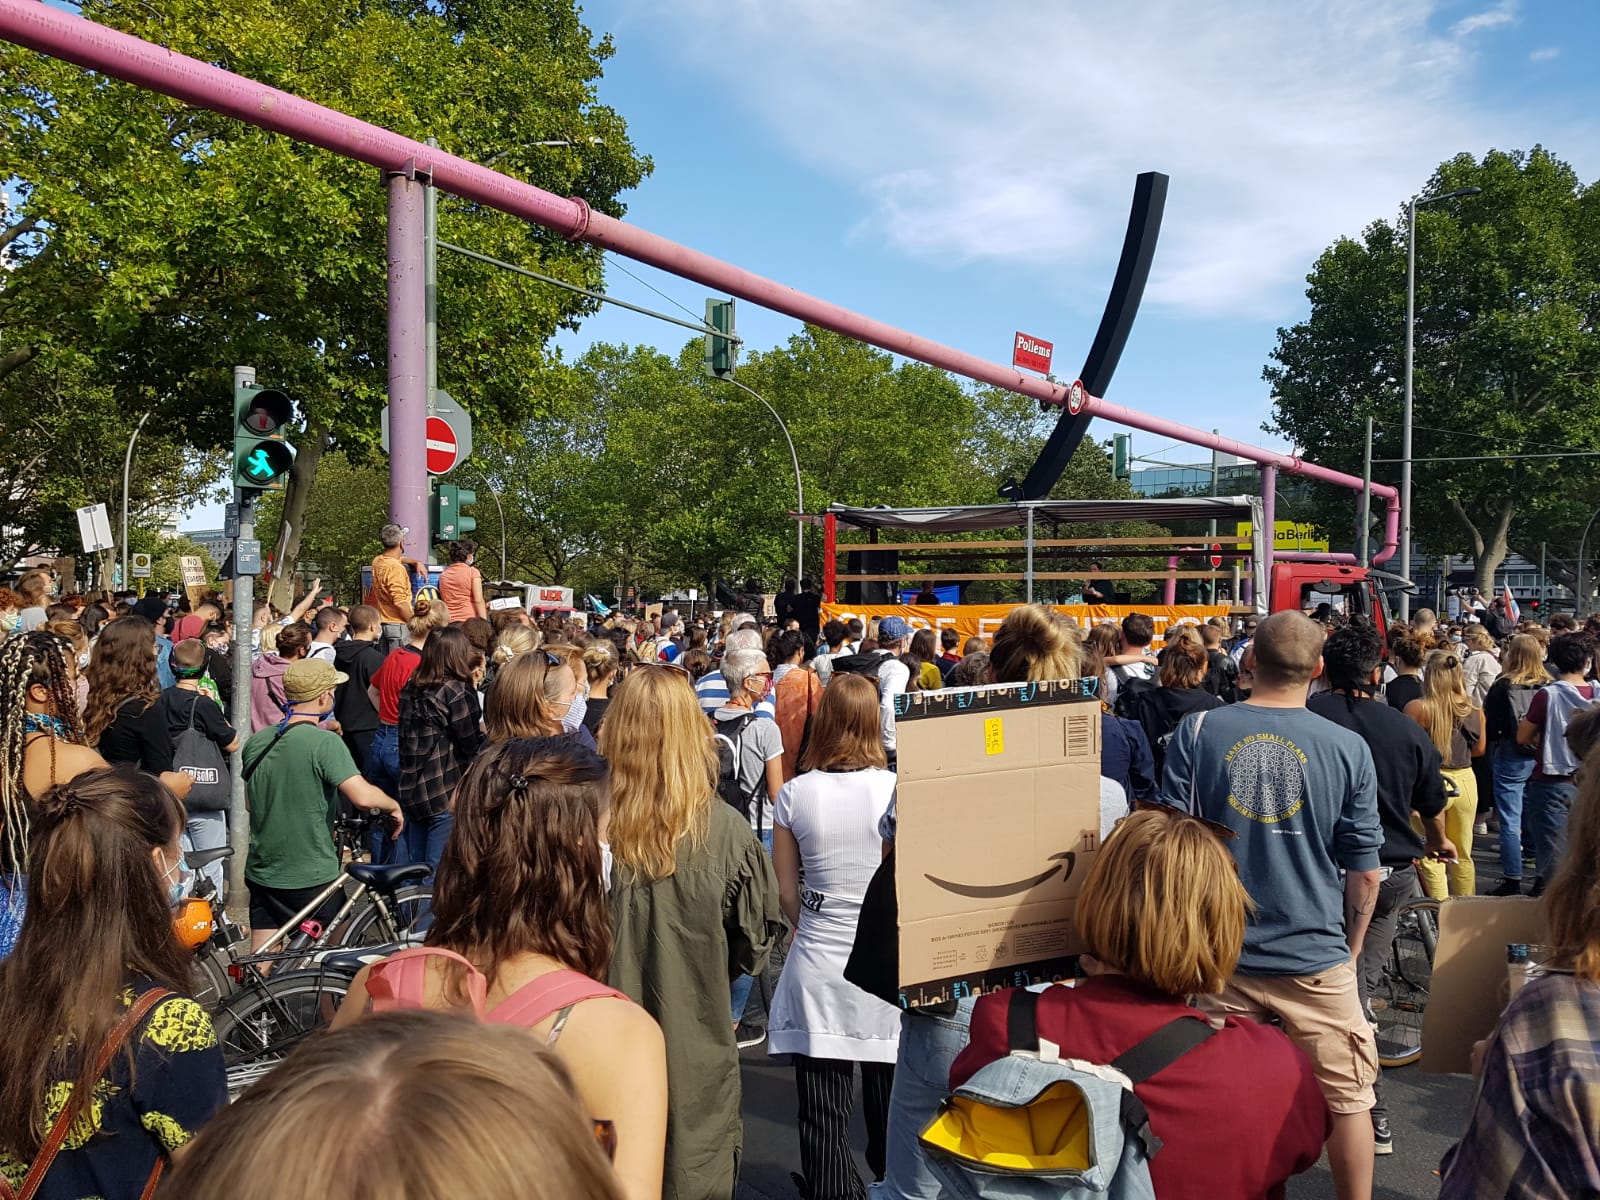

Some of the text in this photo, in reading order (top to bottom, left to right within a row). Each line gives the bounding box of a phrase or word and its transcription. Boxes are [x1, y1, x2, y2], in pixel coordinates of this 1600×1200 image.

[187, 558, 197, 566] NO
[894, 693, 904, 716] prim
[1243, 735, 1255, 744] NO
[1256, 732, 1284, 744] SMALL
[1286, 740, 1308, 764] PLANS
